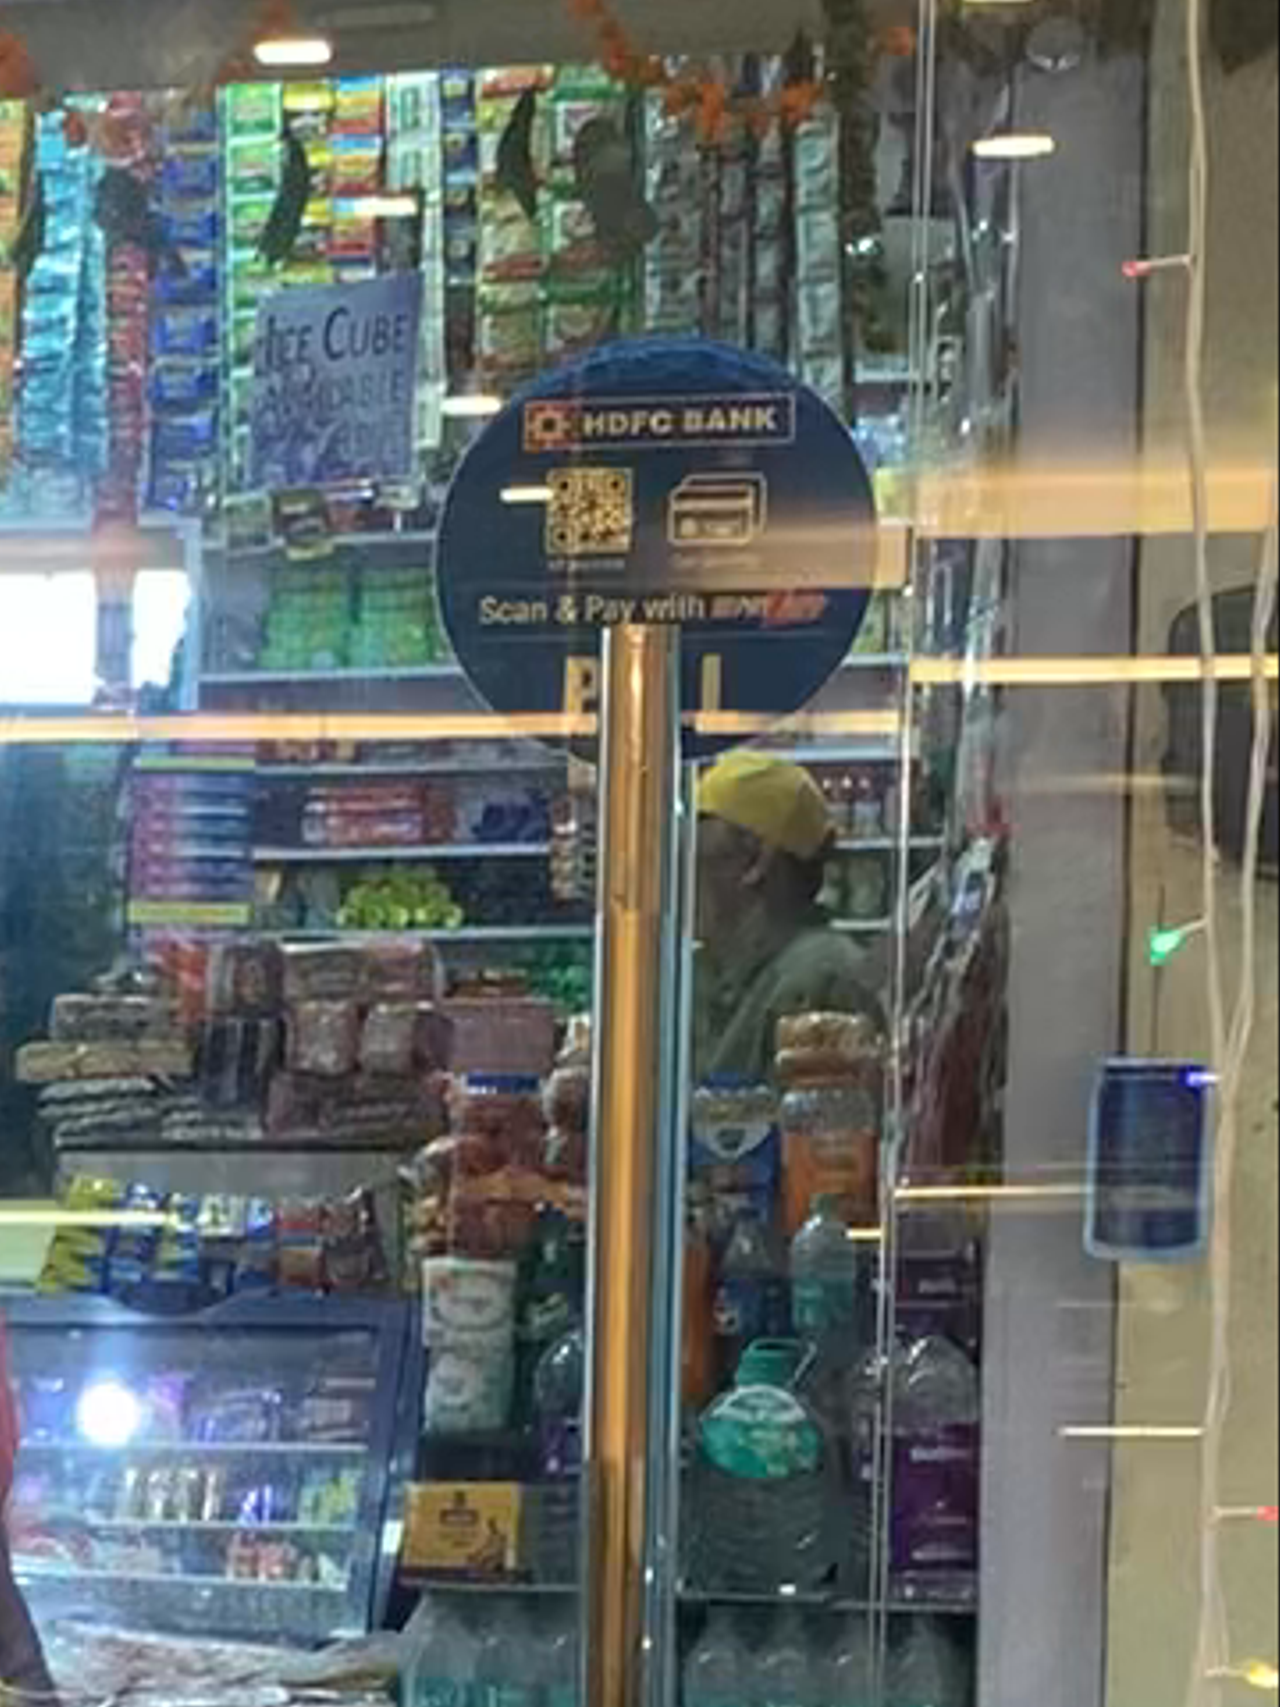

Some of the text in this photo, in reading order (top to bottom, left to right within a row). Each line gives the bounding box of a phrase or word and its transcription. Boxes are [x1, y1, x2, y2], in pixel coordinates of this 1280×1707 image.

[322, 305, 409, 363] CUBE
[582, 405, 779, 436] HDFC BANK
[478, 595, 548, 626] Scan
[555, 595, 578, 624] &
[584, 593, 637, 628] Pay
[642, 592, 705, 621] with
